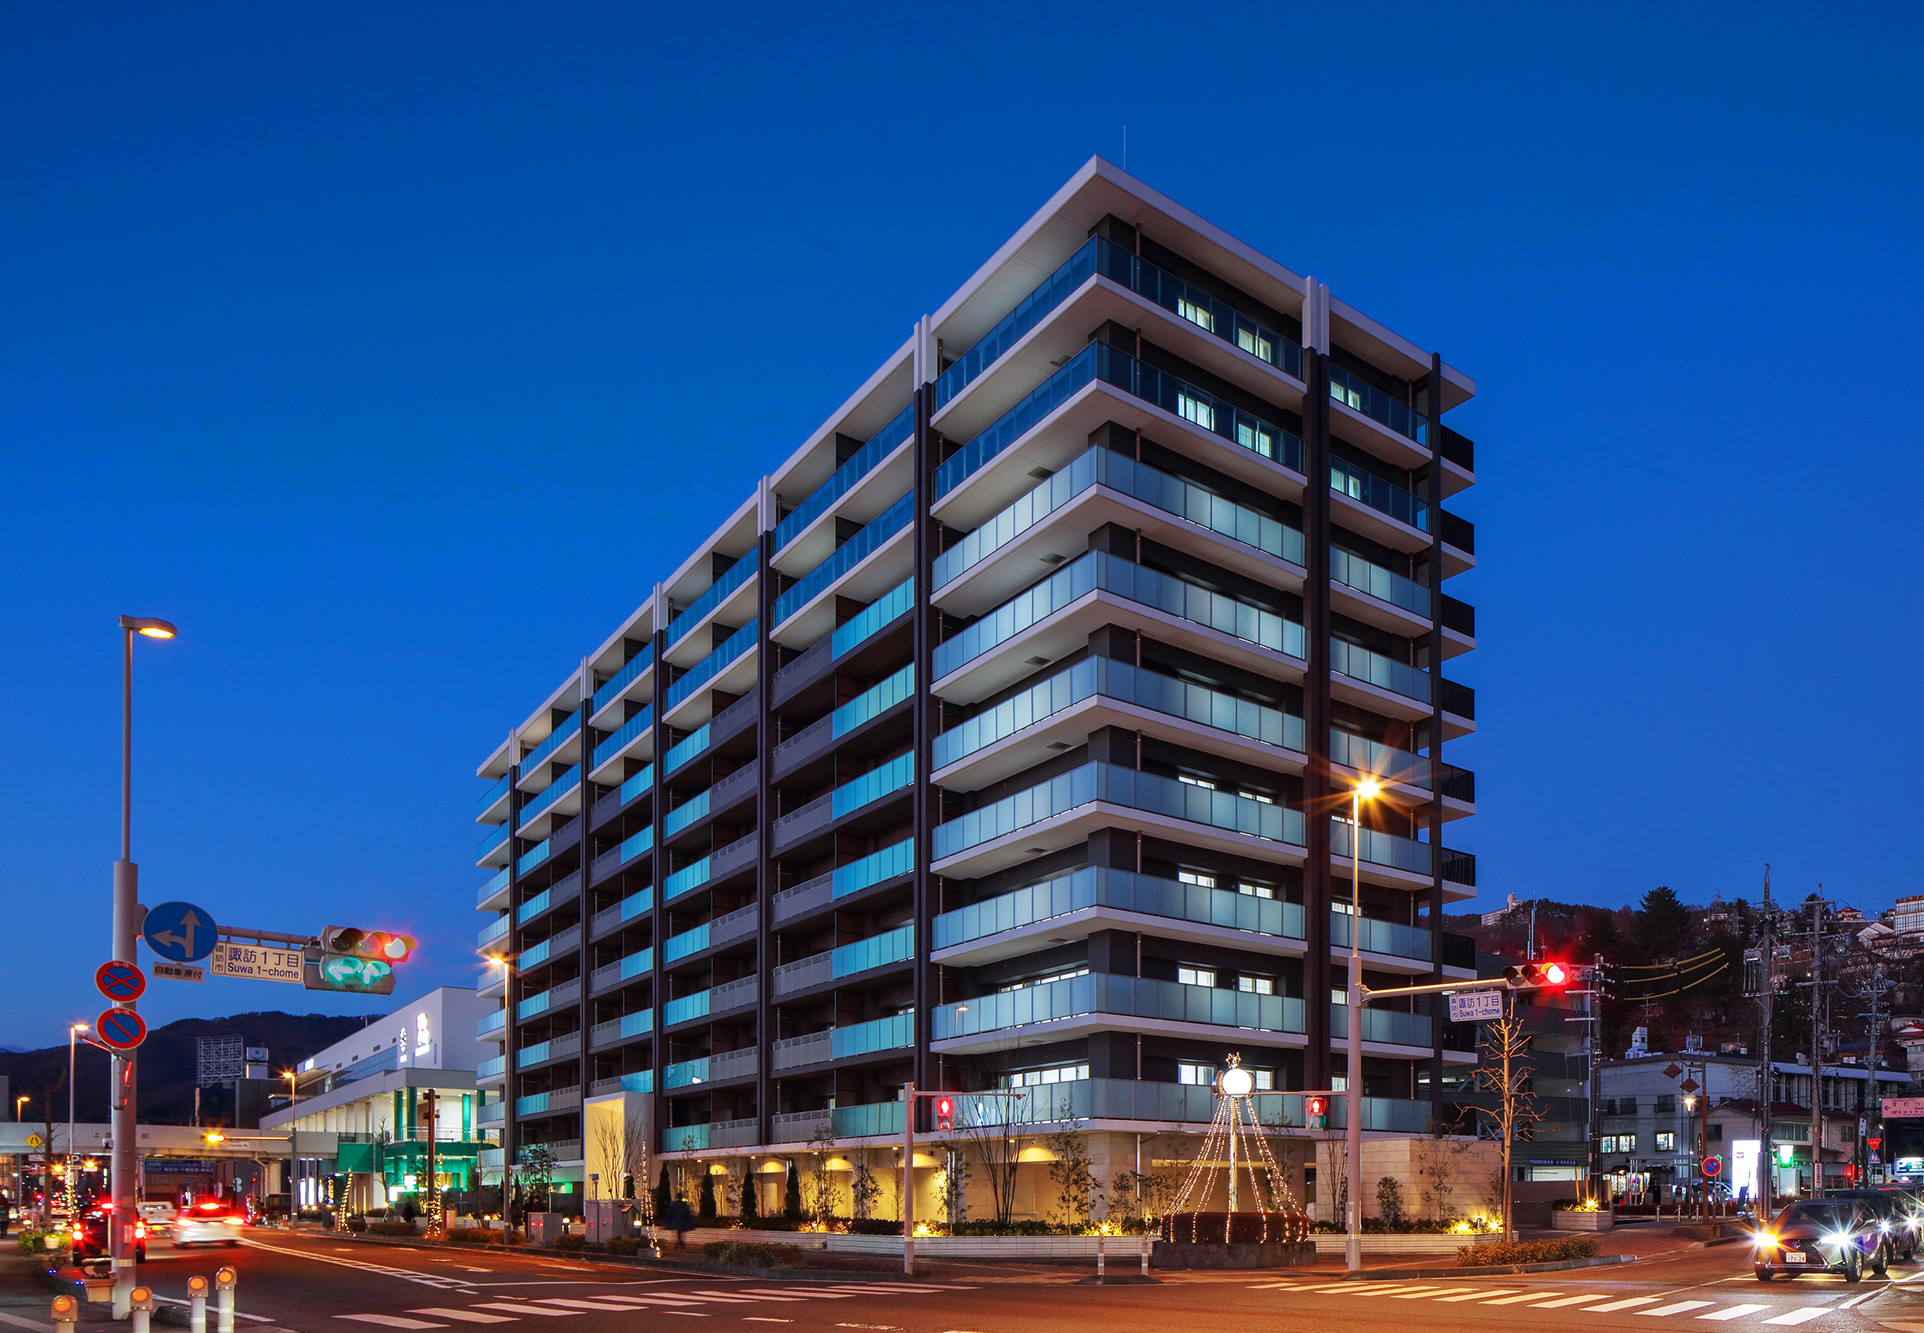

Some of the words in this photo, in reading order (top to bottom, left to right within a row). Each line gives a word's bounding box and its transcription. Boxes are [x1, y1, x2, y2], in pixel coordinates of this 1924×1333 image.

[227, 962, 253, 974] Suwa
[257, 965, 299, 979] 1-chome
[1459, 1009, 1474, 1018] Suwa
[1475, 1007, 1501, 1016] 1-chome
